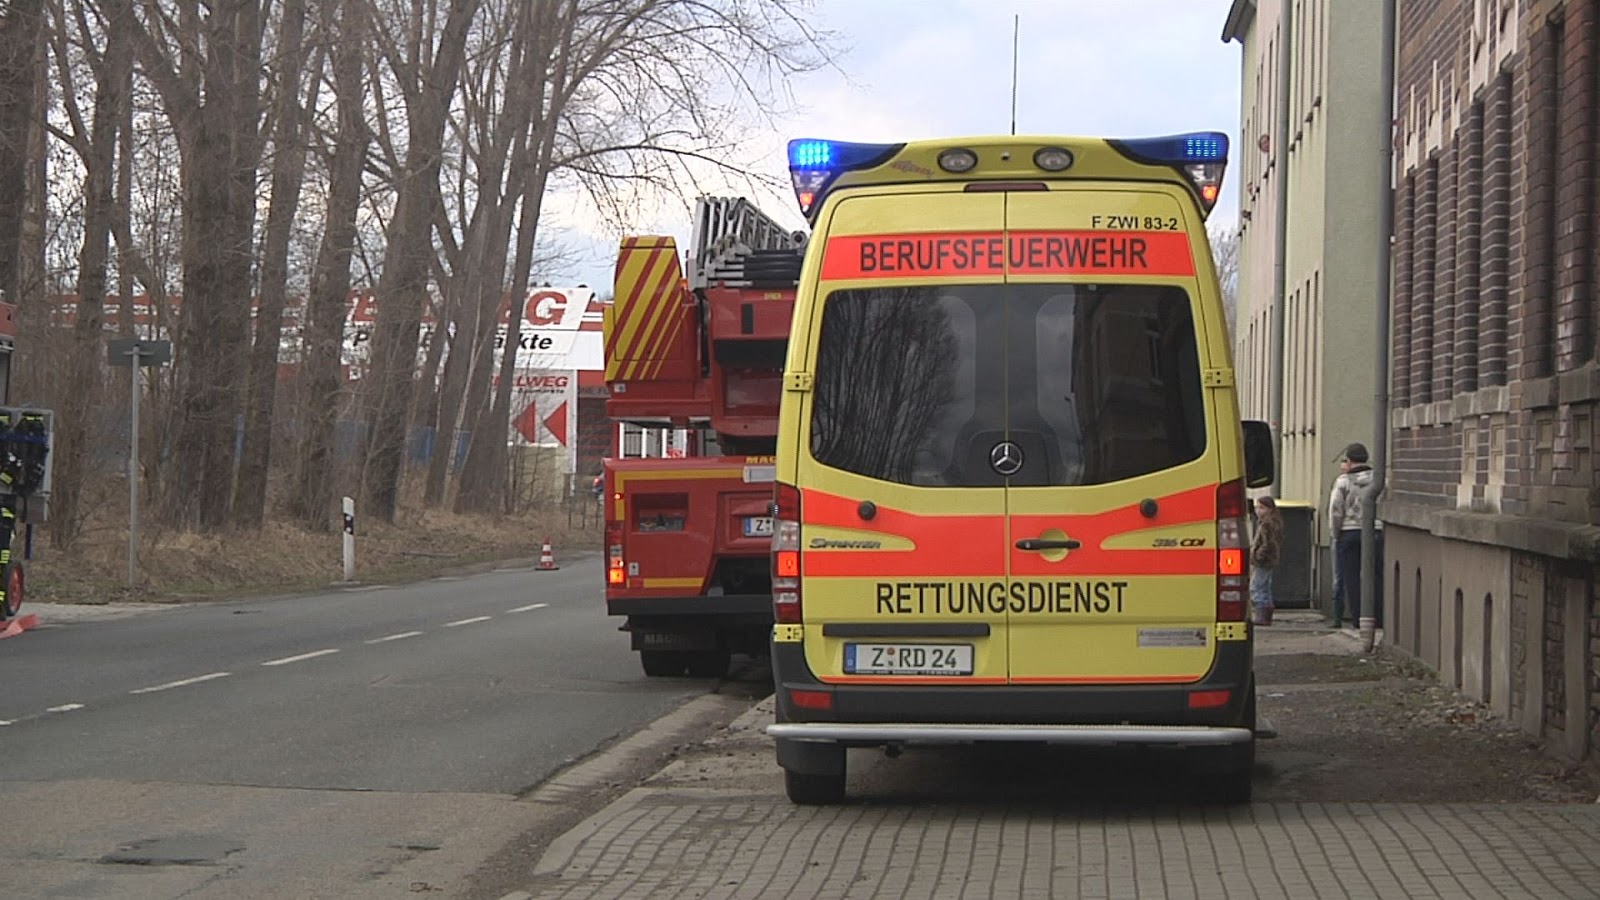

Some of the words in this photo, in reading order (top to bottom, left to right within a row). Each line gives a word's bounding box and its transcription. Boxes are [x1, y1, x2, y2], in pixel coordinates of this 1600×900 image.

[1091, 215, 1102, 229] F
[1106, 215, 1139, 229] ZWI
[1143, 216, 1179, 230] 83-2
[859, 237, 1148, 271] BERUFSFEUERWEHR
[755, 519, 764, 532] Z
[1180, 538, 1206, 547] CDI
[876, 581, 1128, 614] RETTUNGSDIENST
[871, 647, 885, 667] Z
[899, 647, 926, 668] RD
[931, 648, 957, 669] 24
